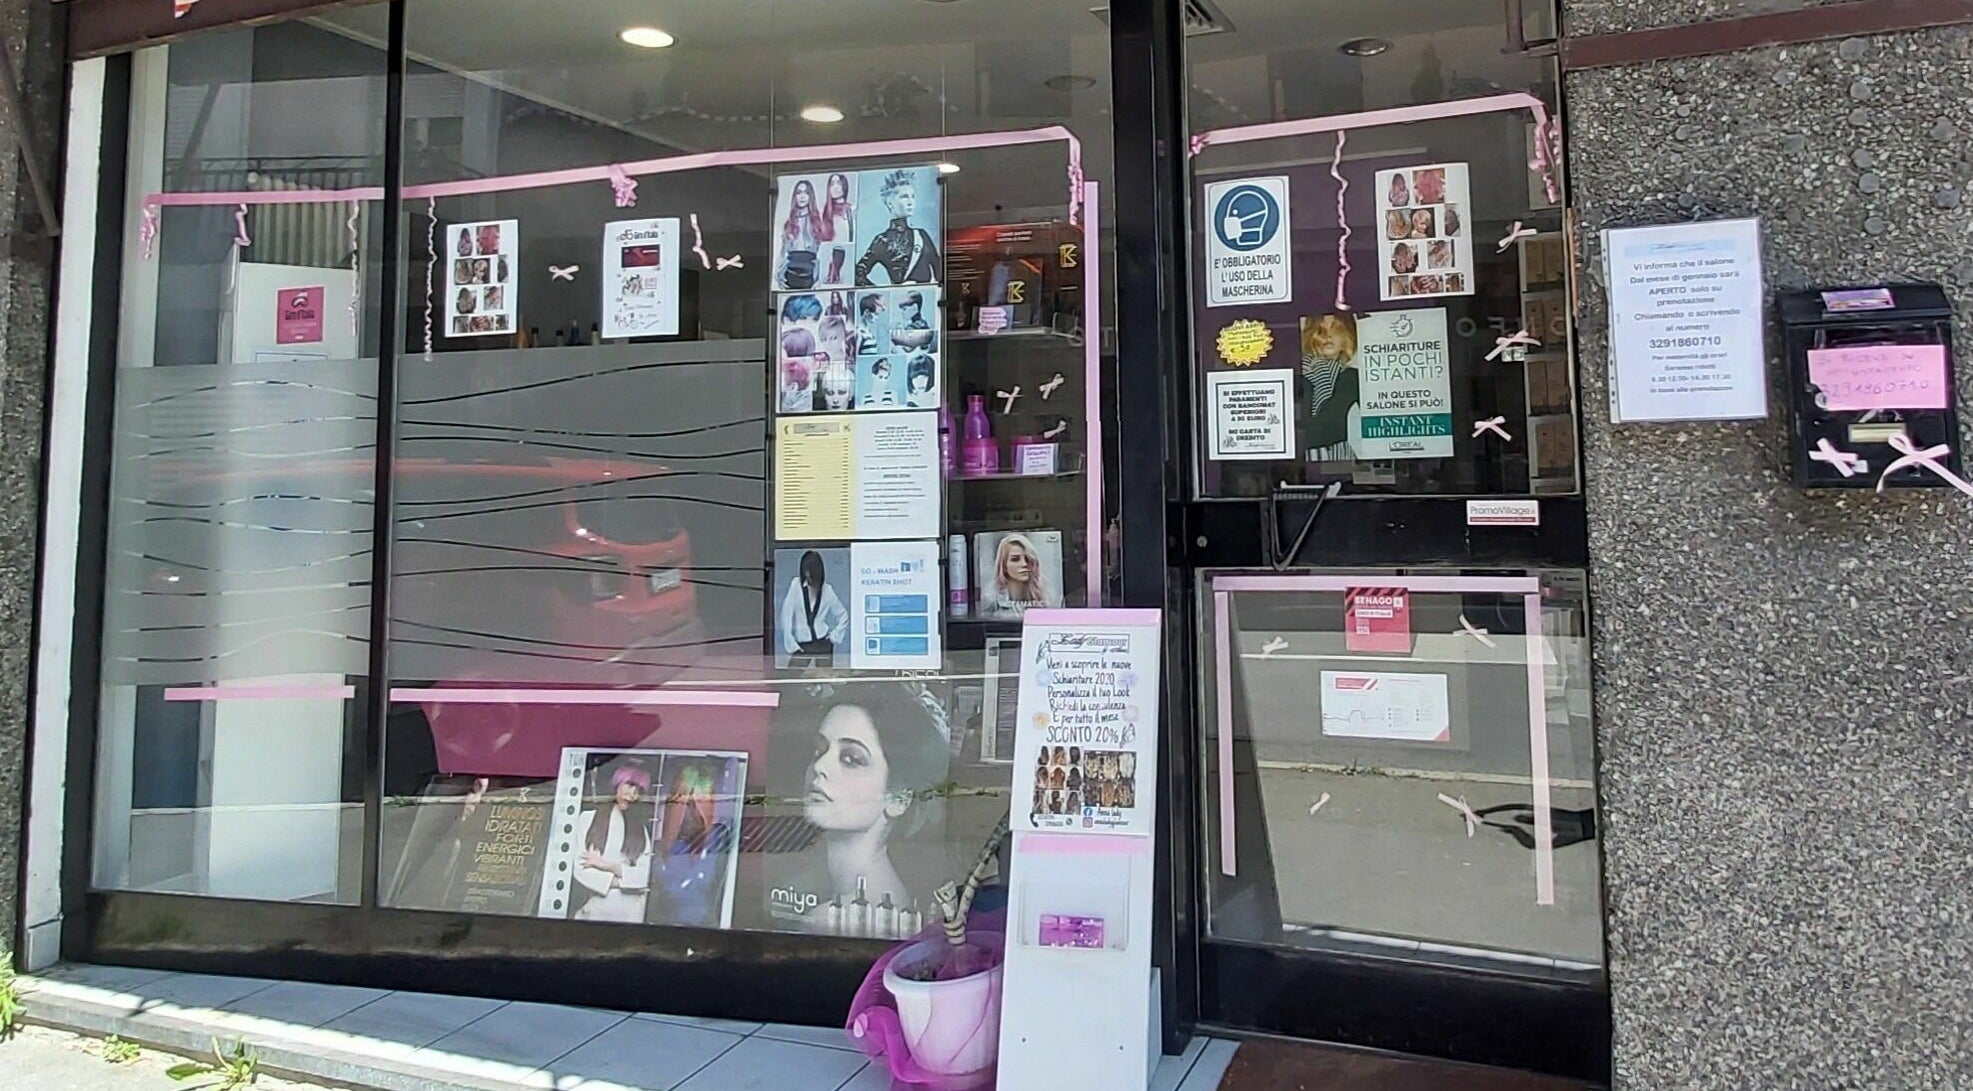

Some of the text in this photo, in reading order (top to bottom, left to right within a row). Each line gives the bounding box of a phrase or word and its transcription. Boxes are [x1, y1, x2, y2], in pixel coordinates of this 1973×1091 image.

[1222, 254, 1281, 268] OBBLIGATORIO
[1643, 262, 1678, 270] informa
[1679, 260, 1696, 268] che
[1705, 258, 1735, 266] salone
[1247, 269, 1274, 281] DELLA
[1630, 276, 1645, 285] Dal
[1681, 272, 1718, 283] gennaio
[1222, 284, 1274, 297] MASCHERINA
[1648, 286, 1687, 296] APERTO
[1690, 285, 1710, 293] solo
[1656, 297, 1715, 307] prenotazione
[1634, 311, 1685, 321] Chiamando
[1696, 308, 1741, 317] scrivendo
[1675, 323, 1710, 331] numero
[1363, 340, 1441, 355] SCHIARITURE
[1649, 336, 1722, 349] 3291860710
[1364, 351, 1443, 369] IN POCHI
[1364, 365, 1444, 383] ISTANTI?
[1378, 389, 1432, 400] IN QUESTO
[1366, 400, 1406, 410] SALONE
[1408, 400, 1417, 408] SI
[1380, 415, 1433, 427] INSTANT
[1368, 424, 1447, 437] HIGHLIGHTS
[1071, 660, 1100, 674] scoprire
[1111, 661, 1132, 670] nuove
[1094, 672, 1116, 686] 2020
[1047, 685, 1090, 698] Personalizza
[1046, 725, 1119, 744] SCONTO 20%
[484, 820, 543, 835] IDRATATI
[475, 842, 536, 855] ENERGICI
[474, 853, 525, 866] VIBRANTI
[771, 885, 818, 914] miya
